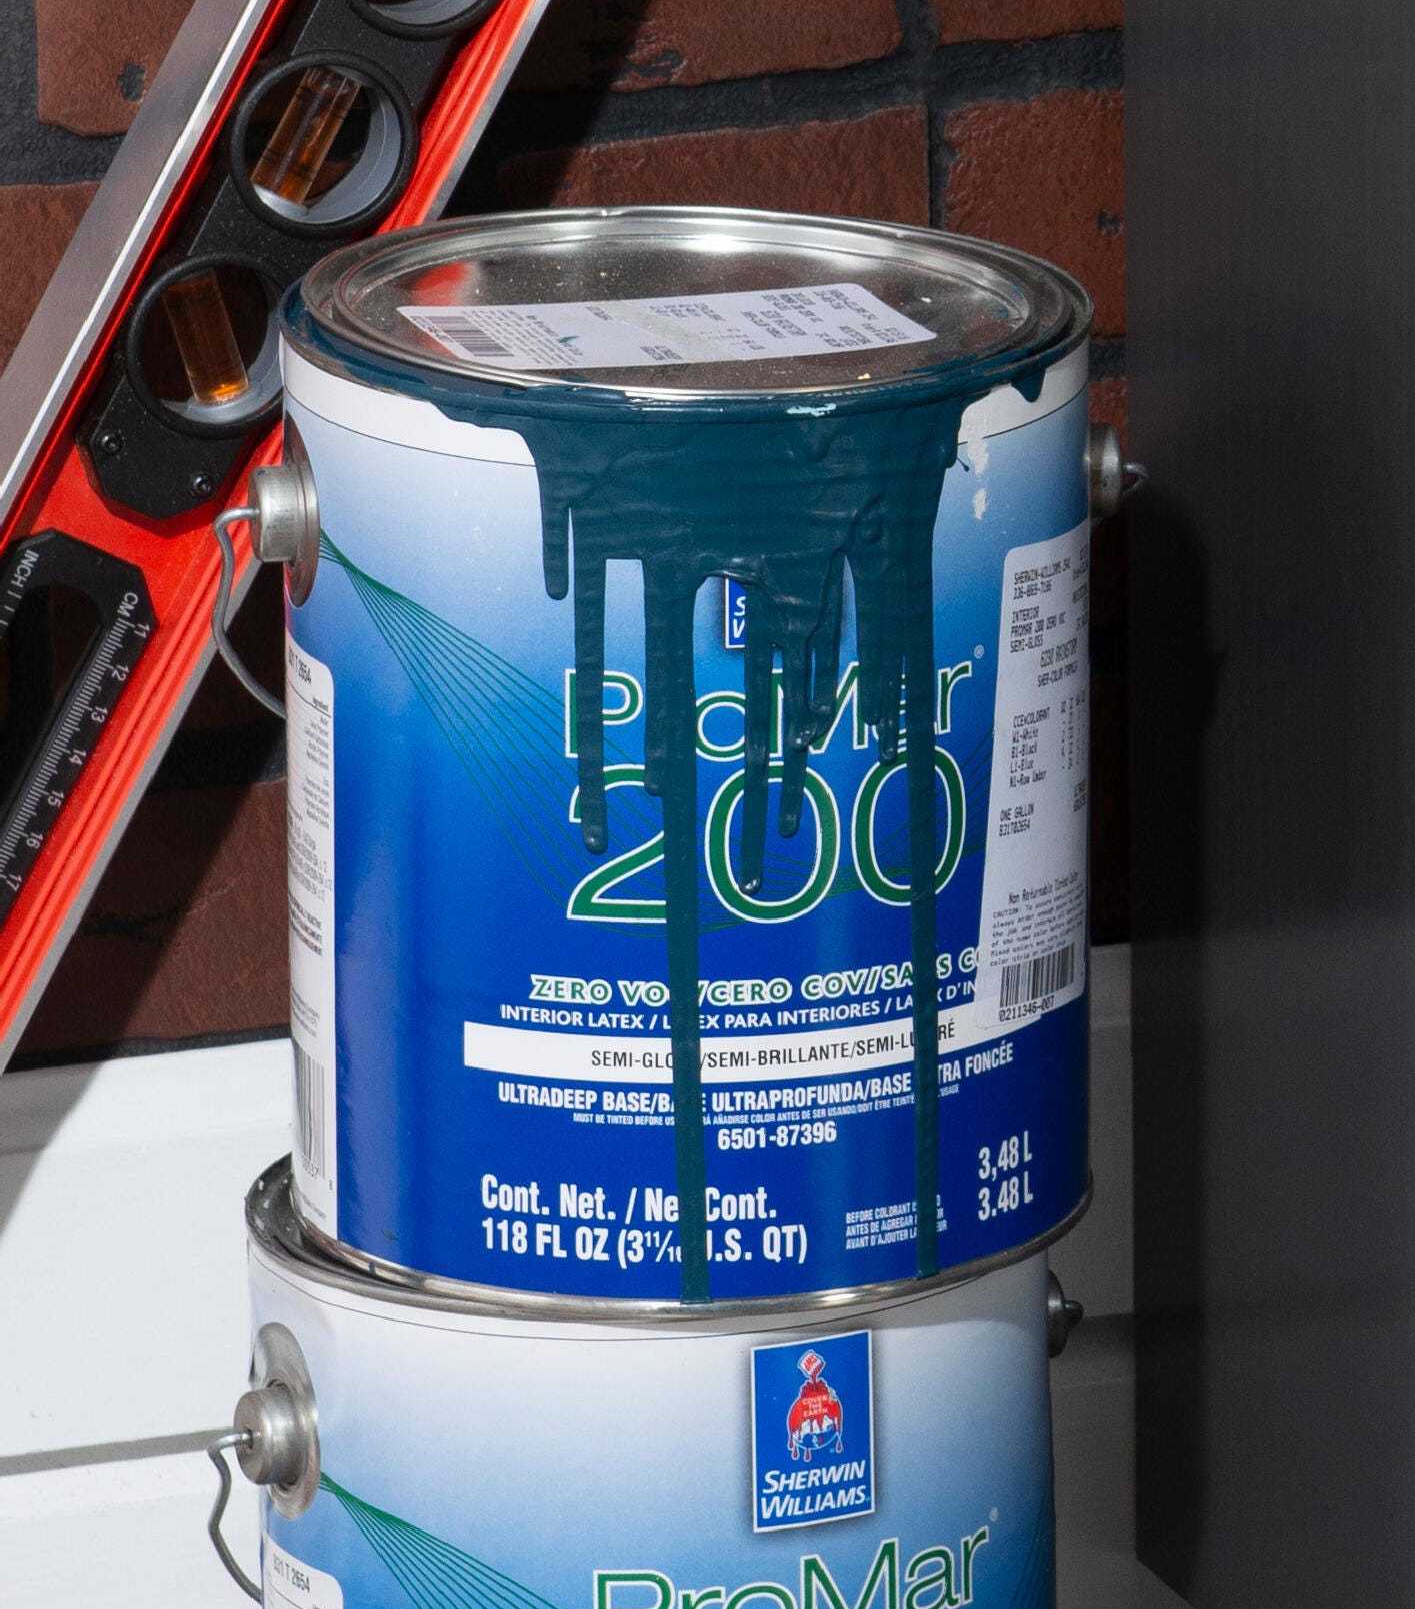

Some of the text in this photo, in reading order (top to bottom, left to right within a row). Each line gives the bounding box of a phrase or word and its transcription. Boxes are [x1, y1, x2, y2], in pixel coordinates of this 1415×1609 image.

[119, 591, 140, 619] CM
[1011, 605, 1040, 623] INTERIOR
[566, 741, 966, 923] 200
[529, 974, 793, 1007] ZERO VO/CERO
[500, 999, 881, 1030] INTERIOR LATEX PARA INTERIORES
[498, 1041, 1014, 1114] ULTRADEEP ULTRAPROFUNDA/BASE FONCÉE
[573, 1112, 594, 1124] MUST
[607, 1114, 634, 1125] TINTED
[635, 1114, 664, 1126] BEFORE
[750, 1112, 776, 1125] COLOR
[777, 1110, 800, 1123] ANTES
[801, 1109, 811, 1120] DE
[812, 1107, 827, 1119] SER
[717, 1121, 838, 1151] 6501-87396
[978, 1130, 1032, 1181] 3,48 L
[481, 1174, 550, 1216] Cont.
[560, 1183, 616, 1220] Net.
[705, 1186, 777, 1222] Cont.
[978, 1171, 1034, 1221] 3.48 L
[845, 1202, 912, 1224] BEFORE COLORANT
[845, 1216, 915, 1237] ANTES DE AGREGAR
[482, 1217, 808, 1265] 118 FL OZ QT)
[845, 1235, 870, 1250] AVANT
[802, 1395, 828, 1406] COVER
[803, 1408, 829, 1418] EARTH
[808, 1402, 822, 1411] THE
[762, 1459, 866, 1495] SHERWIN
[760, 1485, 866, 1521] WILLIAMS
